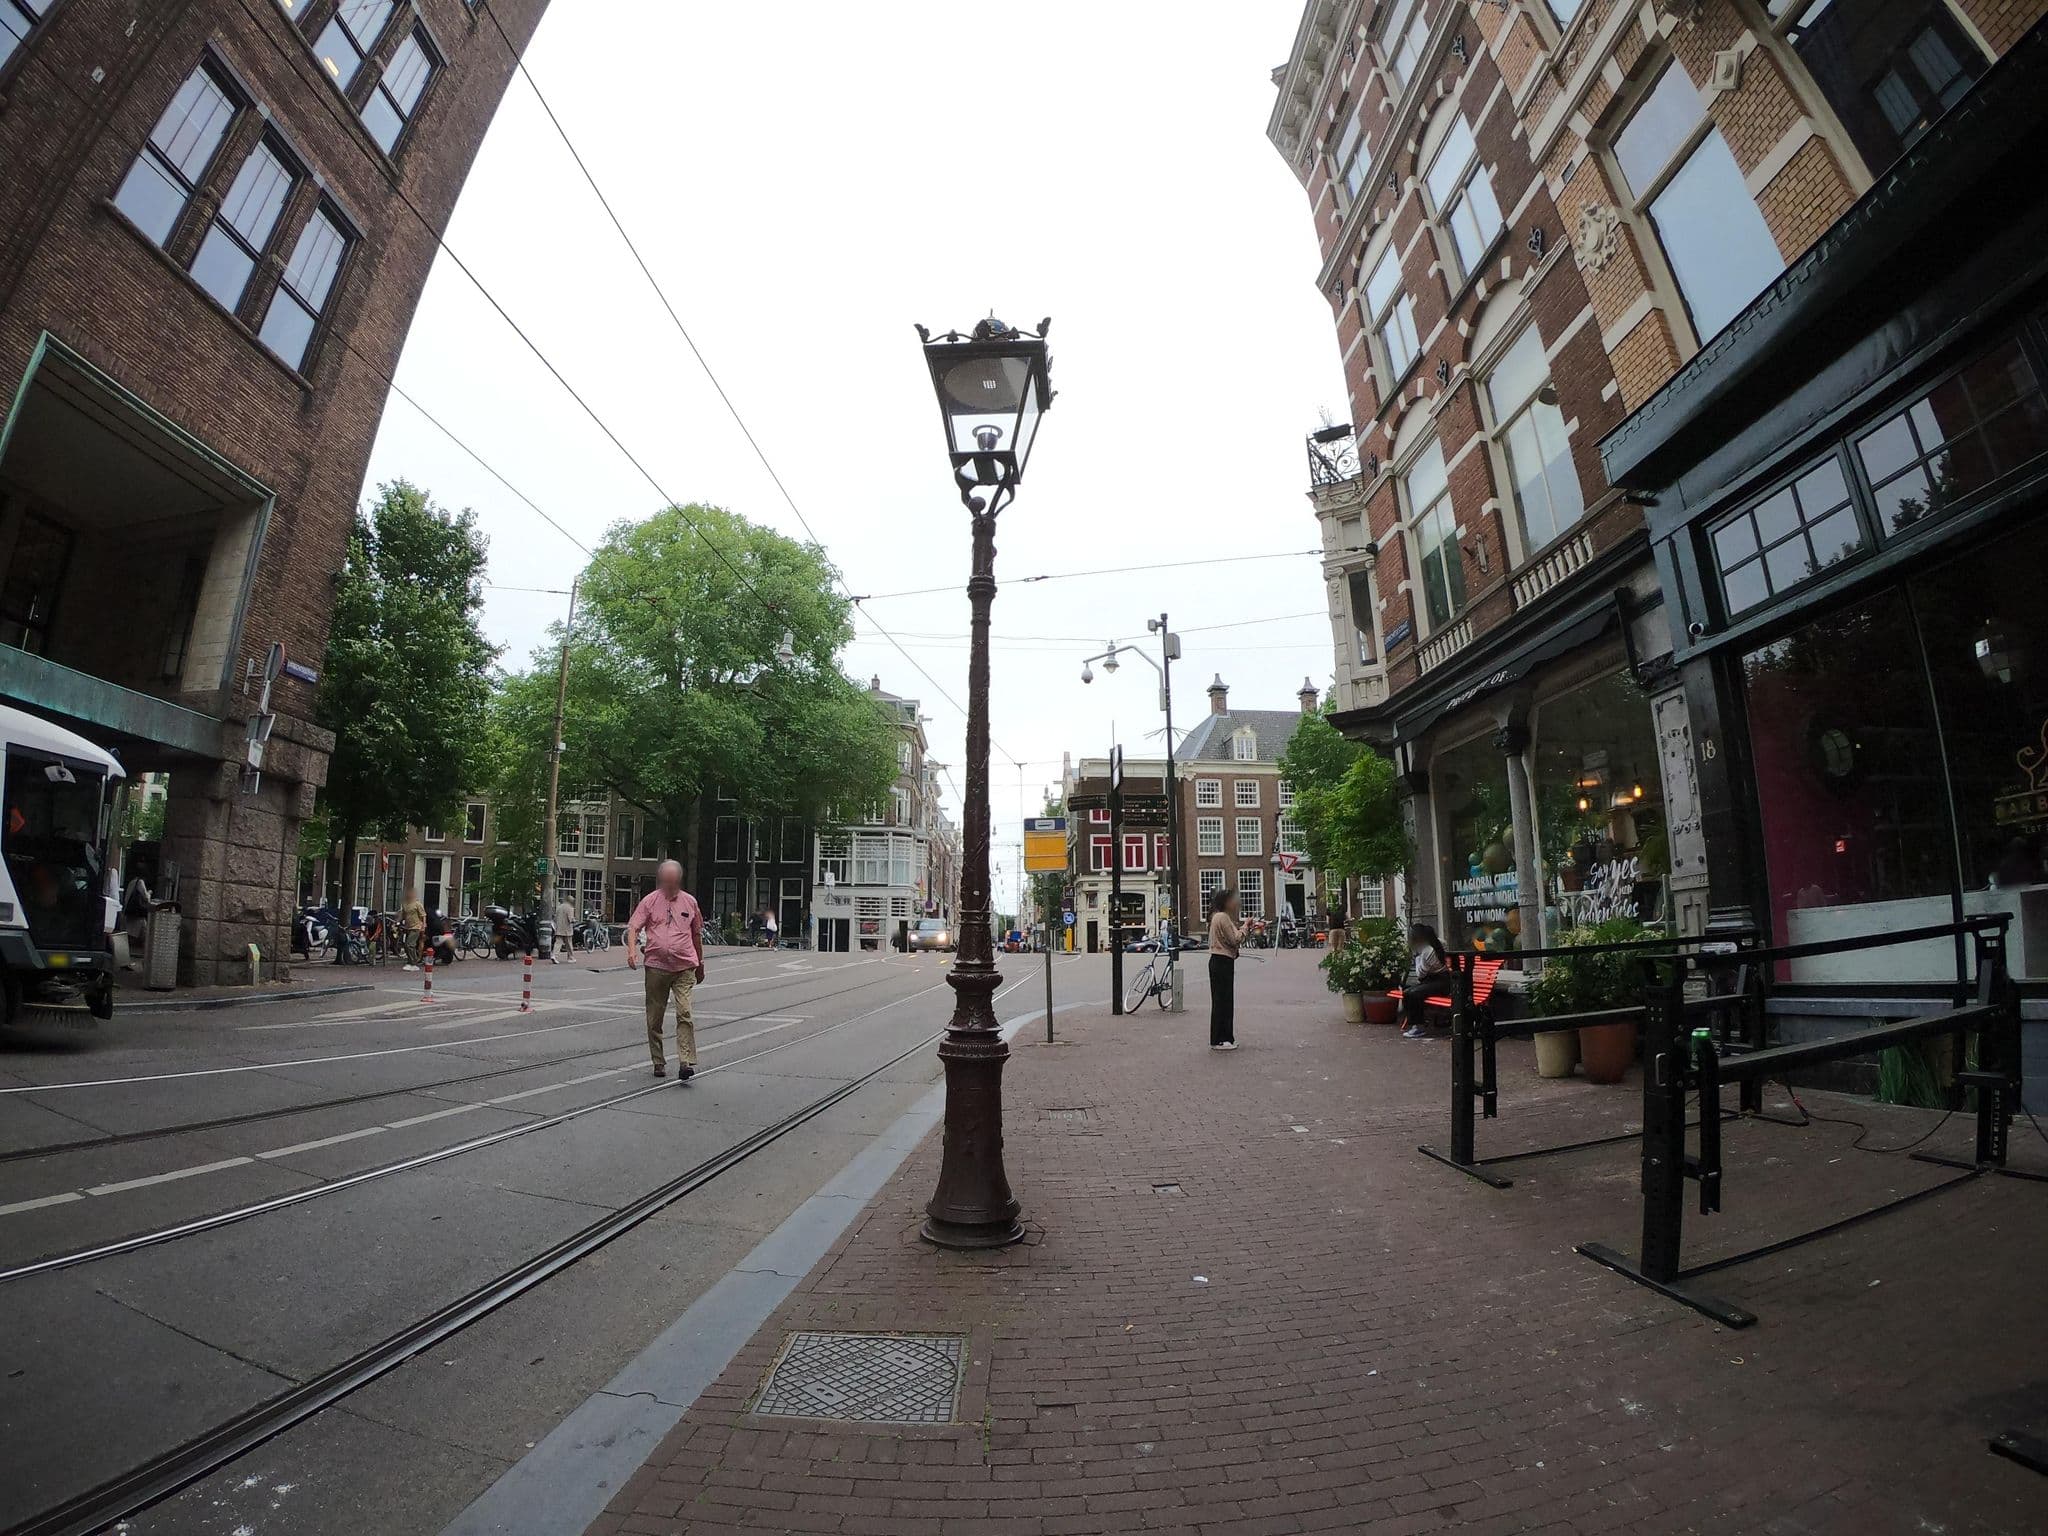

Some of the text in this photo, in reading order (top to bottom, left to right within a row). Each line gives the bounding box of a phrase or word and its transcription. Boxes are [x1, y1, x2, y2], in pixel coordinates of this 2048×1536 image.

[1700, 740, 1716, 761] 18
[1468, 876, 1494, 891] GLOBAL
[1494, 872, 1519, 887] CITIZE
[1454, 894, 1480, 909] BECAUSE
[1494, 890, 1520, 906] WORL
[1466, 910, 1473, 923] IS
[1474, 910, 1484, 923] MY
